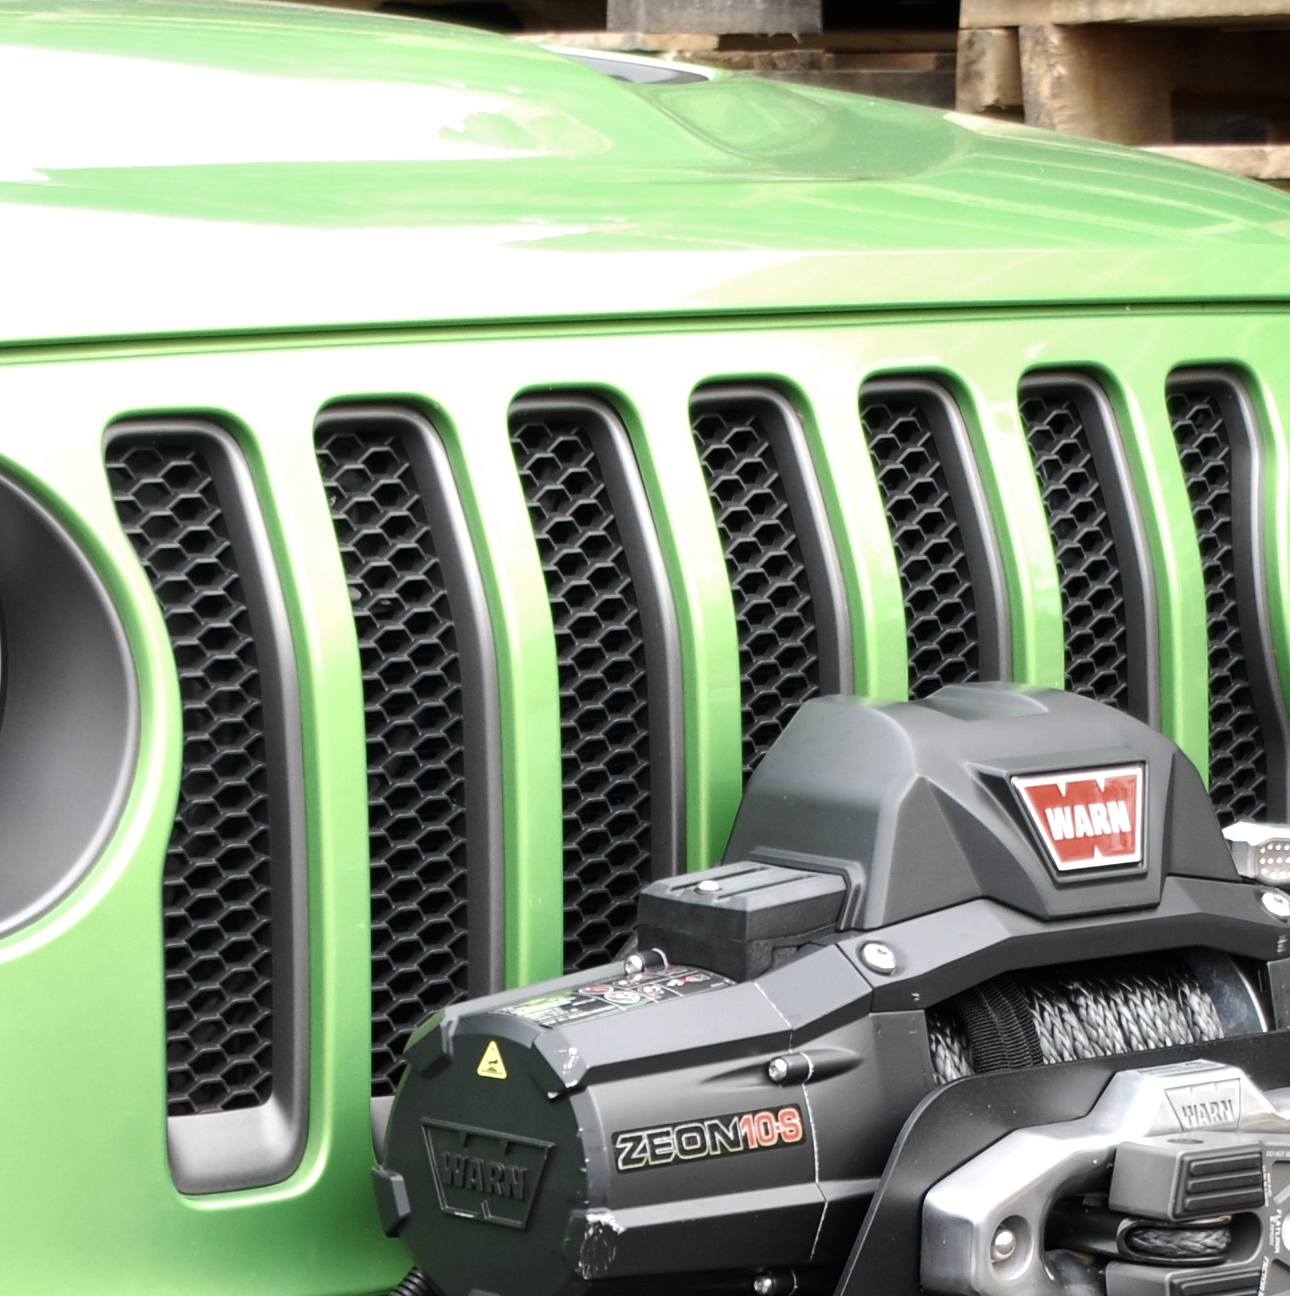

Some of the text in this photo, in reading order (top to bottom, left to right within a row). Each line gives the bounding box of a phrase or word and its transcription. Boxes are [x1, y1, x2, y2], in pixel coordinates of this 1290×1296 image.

[1045, 800, 1131, 841] WARN
[1182, 1098, 1235, 1128] WARN
[442, 1151, 528, 1200] WARN
